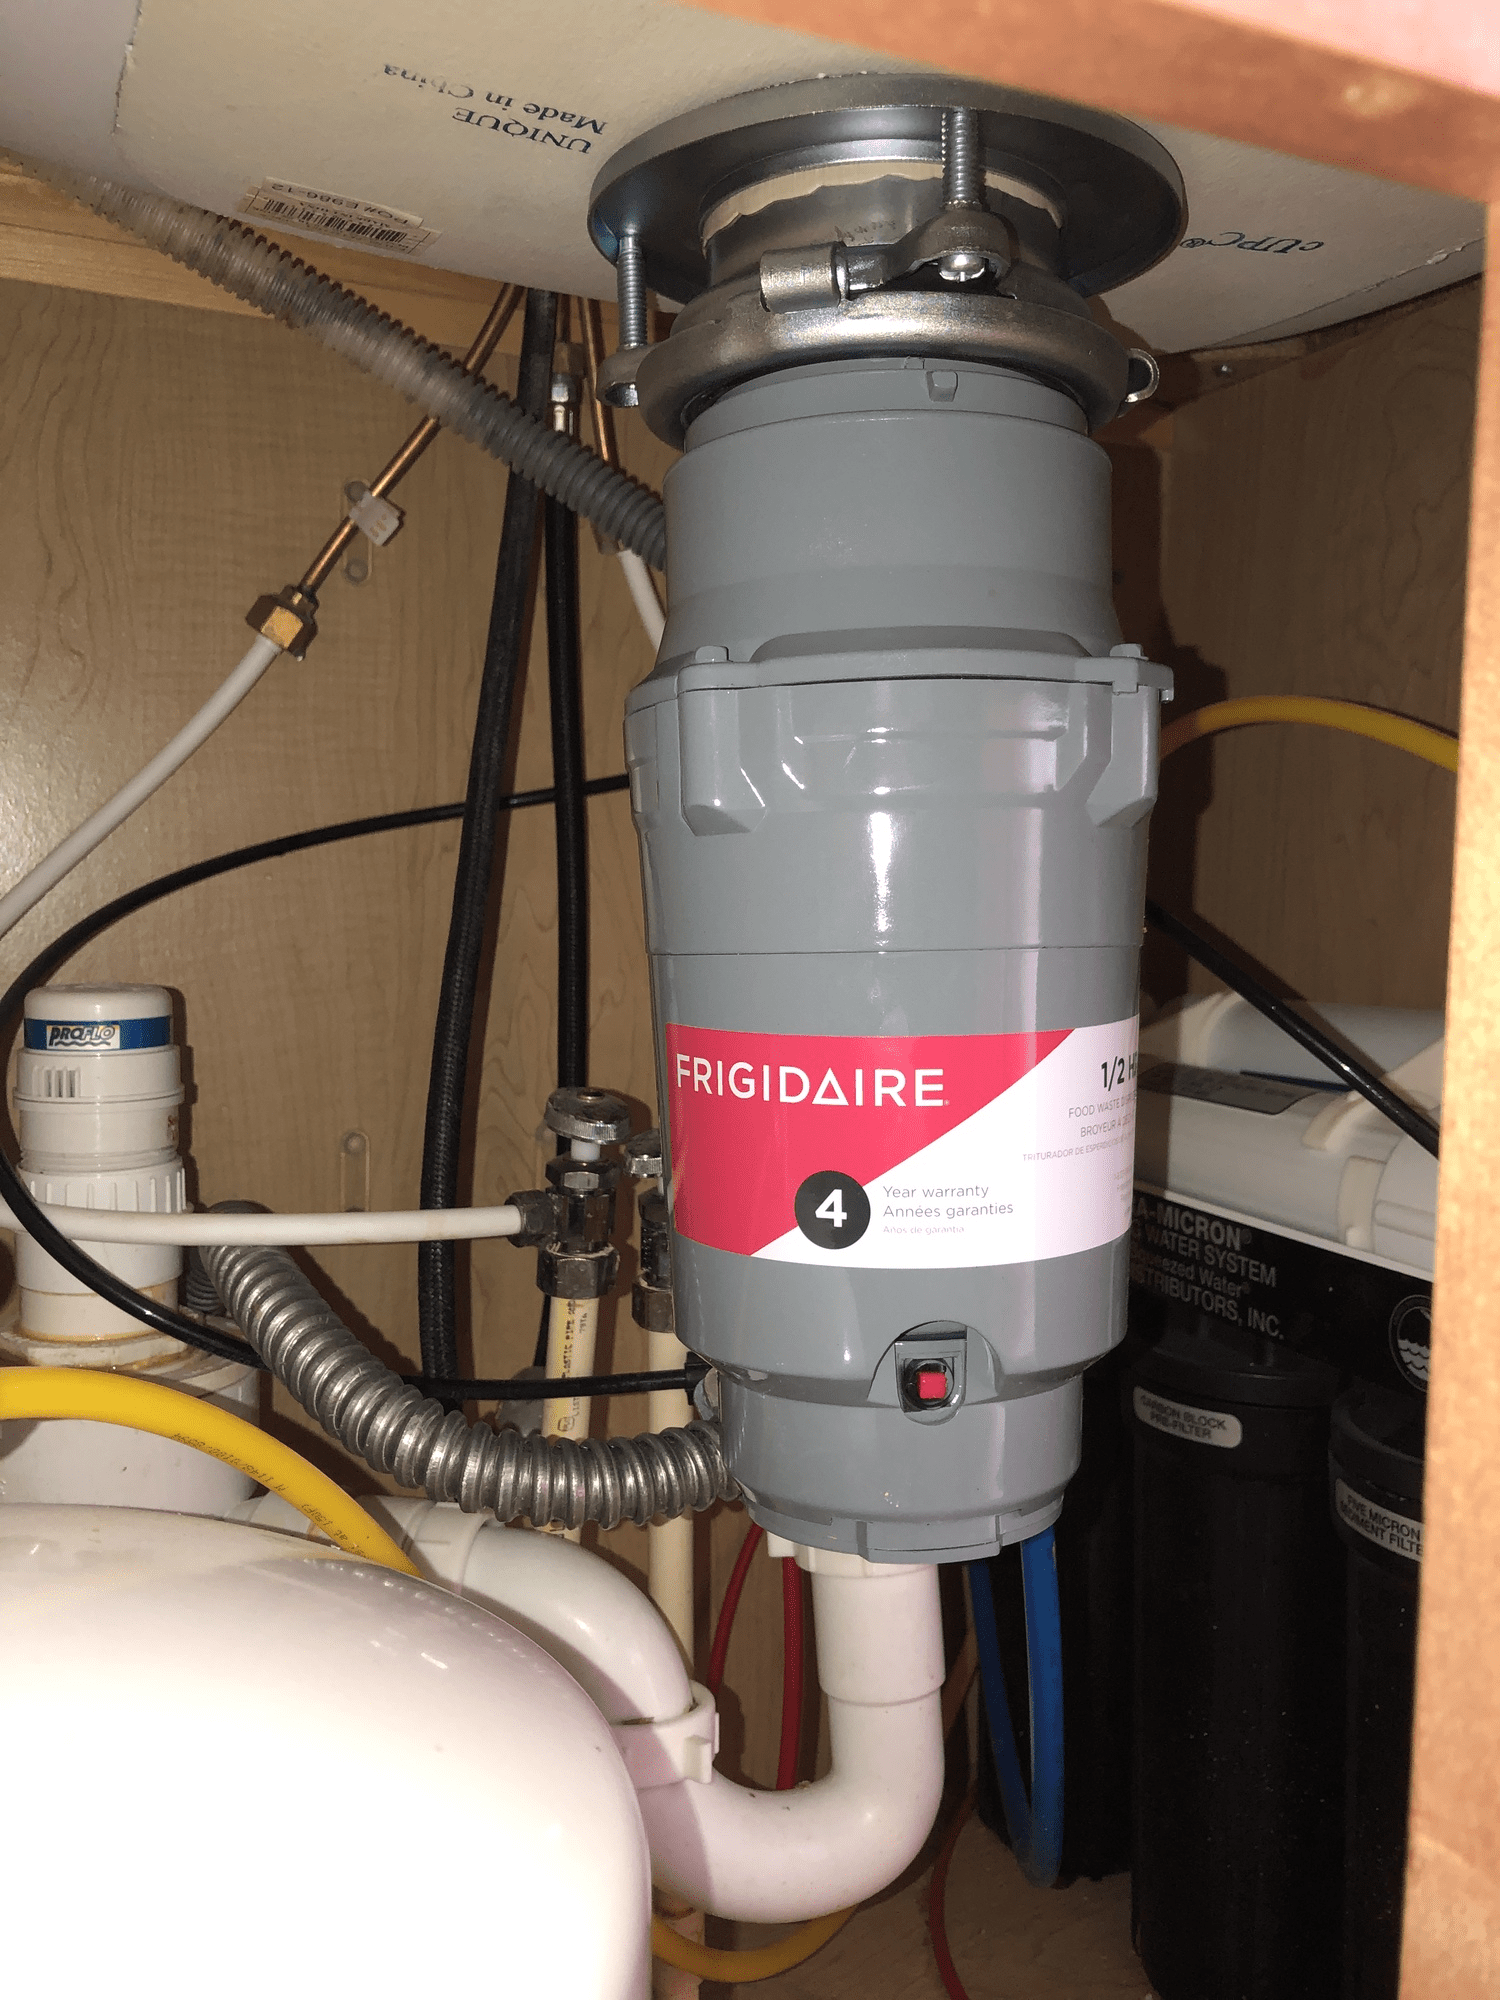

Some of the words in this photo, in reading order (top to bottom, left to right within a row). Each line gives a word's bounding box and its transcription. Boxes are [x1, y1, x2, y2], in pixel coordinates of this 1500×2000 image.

[383, 63, 474, 98] China
[485, 92, 513, 111] in
[452, 106, 592, 154] UNIQUE
[523, 102, 608, 135] Made
[48, 1026, 115, 1047] PROFLO
[676, 1053, 944, 1107] FRIGIDAIRE
[1101, 1055, 1125, 1092] 1/2
[1068, 1104, 1095, 1119] FOOD
[1097, 1097, 1120, 1114] WASTE
[1080, 1119, 1116, 1138] BROYEUR
[1022, 1148, 1074, 1162] TRITURADOR
[1074, 1146, 1084, 1156] DE
[883, 1186, 916, 1199] Year
[922, 1185, 989, 1199] warranty
[814, 1187, 848, 1229] 4
[883, 1204, 941, 1218] Années
[946, 1203, 1014, 1219] garanties
[910, 1225, 922, 1235] de
[1145, 1223, 1201, 1261] WATER
[1204, 1244, 1277, 1288] SYSTEM
[1247, 1306, 1285, 1340] INC.
[1183, 1411, 1228, 1431] BLOCK
[1369, 1508, 1421, 1541] MICRON
